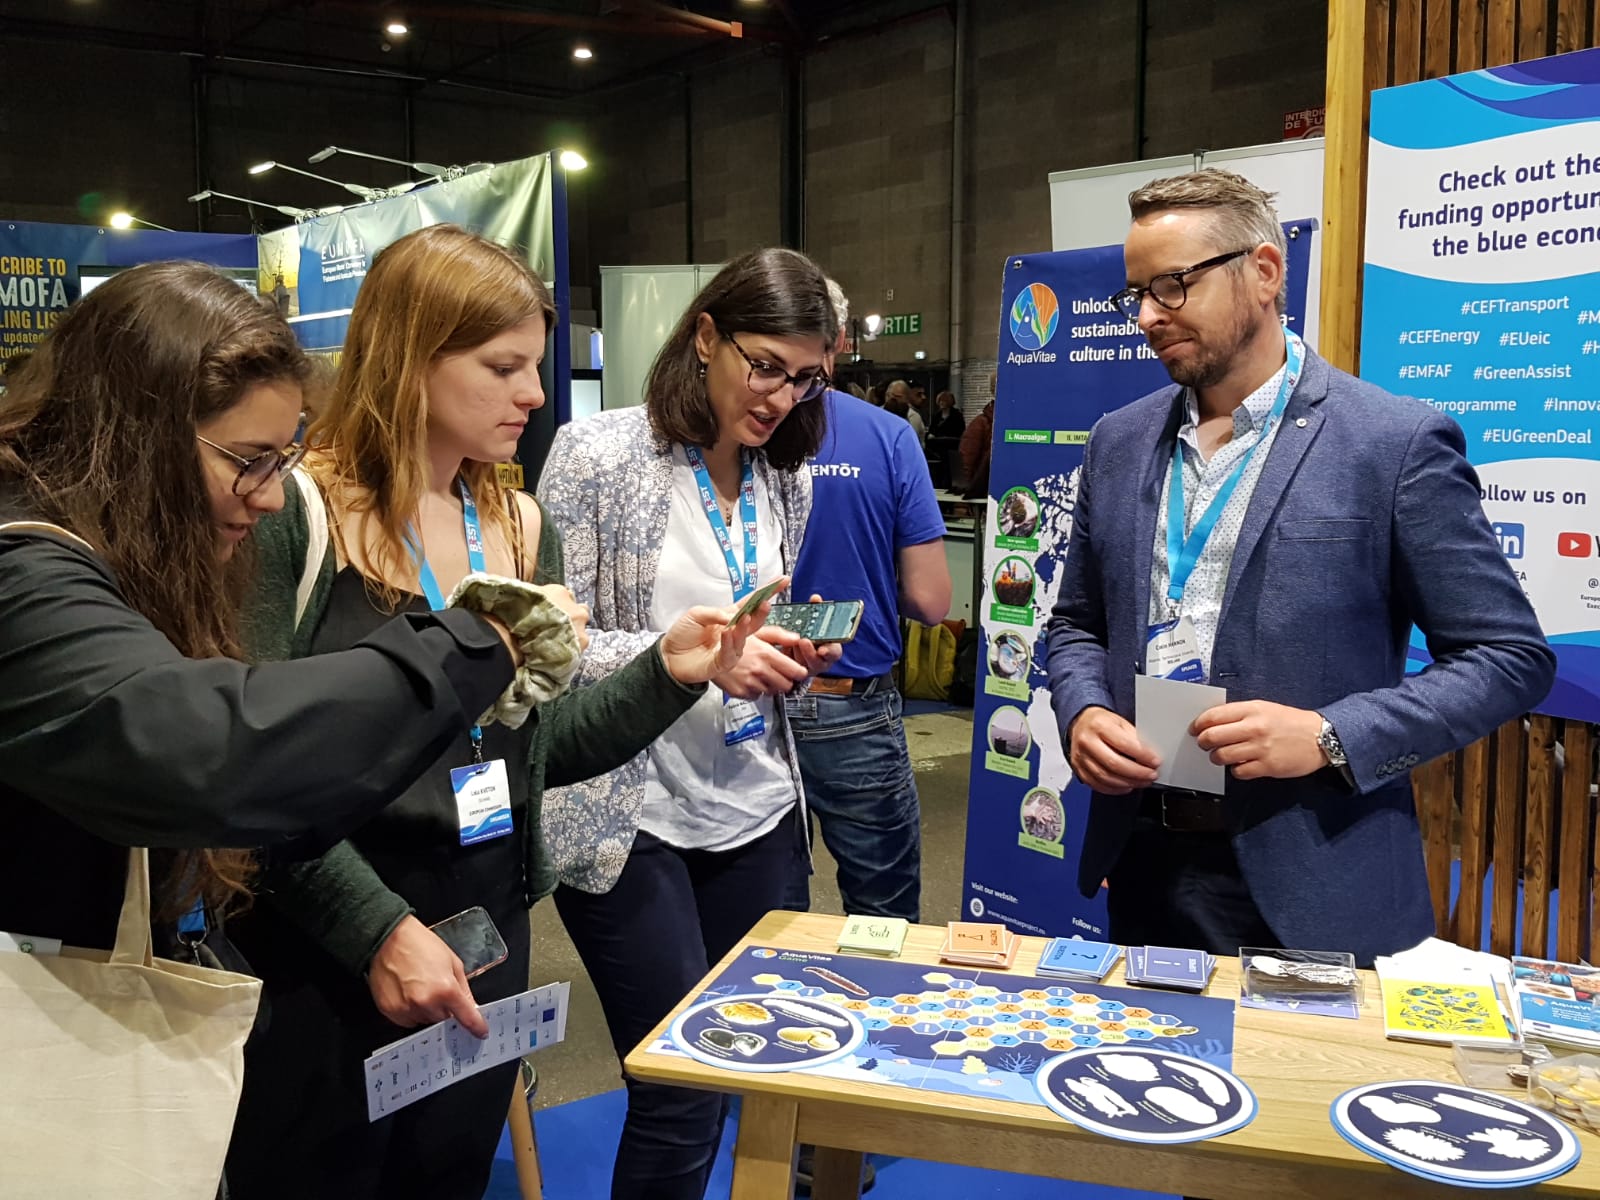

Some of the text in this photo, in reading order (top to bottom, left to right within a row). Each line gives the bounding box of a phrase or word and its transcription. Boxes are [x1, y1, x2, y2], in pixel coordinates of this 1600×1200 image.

[1285, 121, 1300, 130] DE
[1439, 153, 1600, 193] Check out the
[1398, 203, 1484, 230] funding
[1432, 226, 1600, 257] the blue econ
[47, 258, 67, 276] TO
[1461, 296, 1570, 316] #CEFTransport
[1399, 329, 1551, 346] #CEFEnergy #EUeic
[1006, 351, 1057, 366] AquaVitae
[1069, 343, 1159, 362] culture in the
[1399, 364, 1572, 380] #EMFAF #GreenAssist
[1419, 398, 1517, 415] Eprogramme
[1014, 433, 1048, 443] Macroalgae
[1482, 429, 1592, 444] #EUGreenDeal
[1480, 484, 1587, 505] ollow us on
[971, 881, 1019, 904] Visit our website:
[1072, 916, 1102, 935] Follow us:
